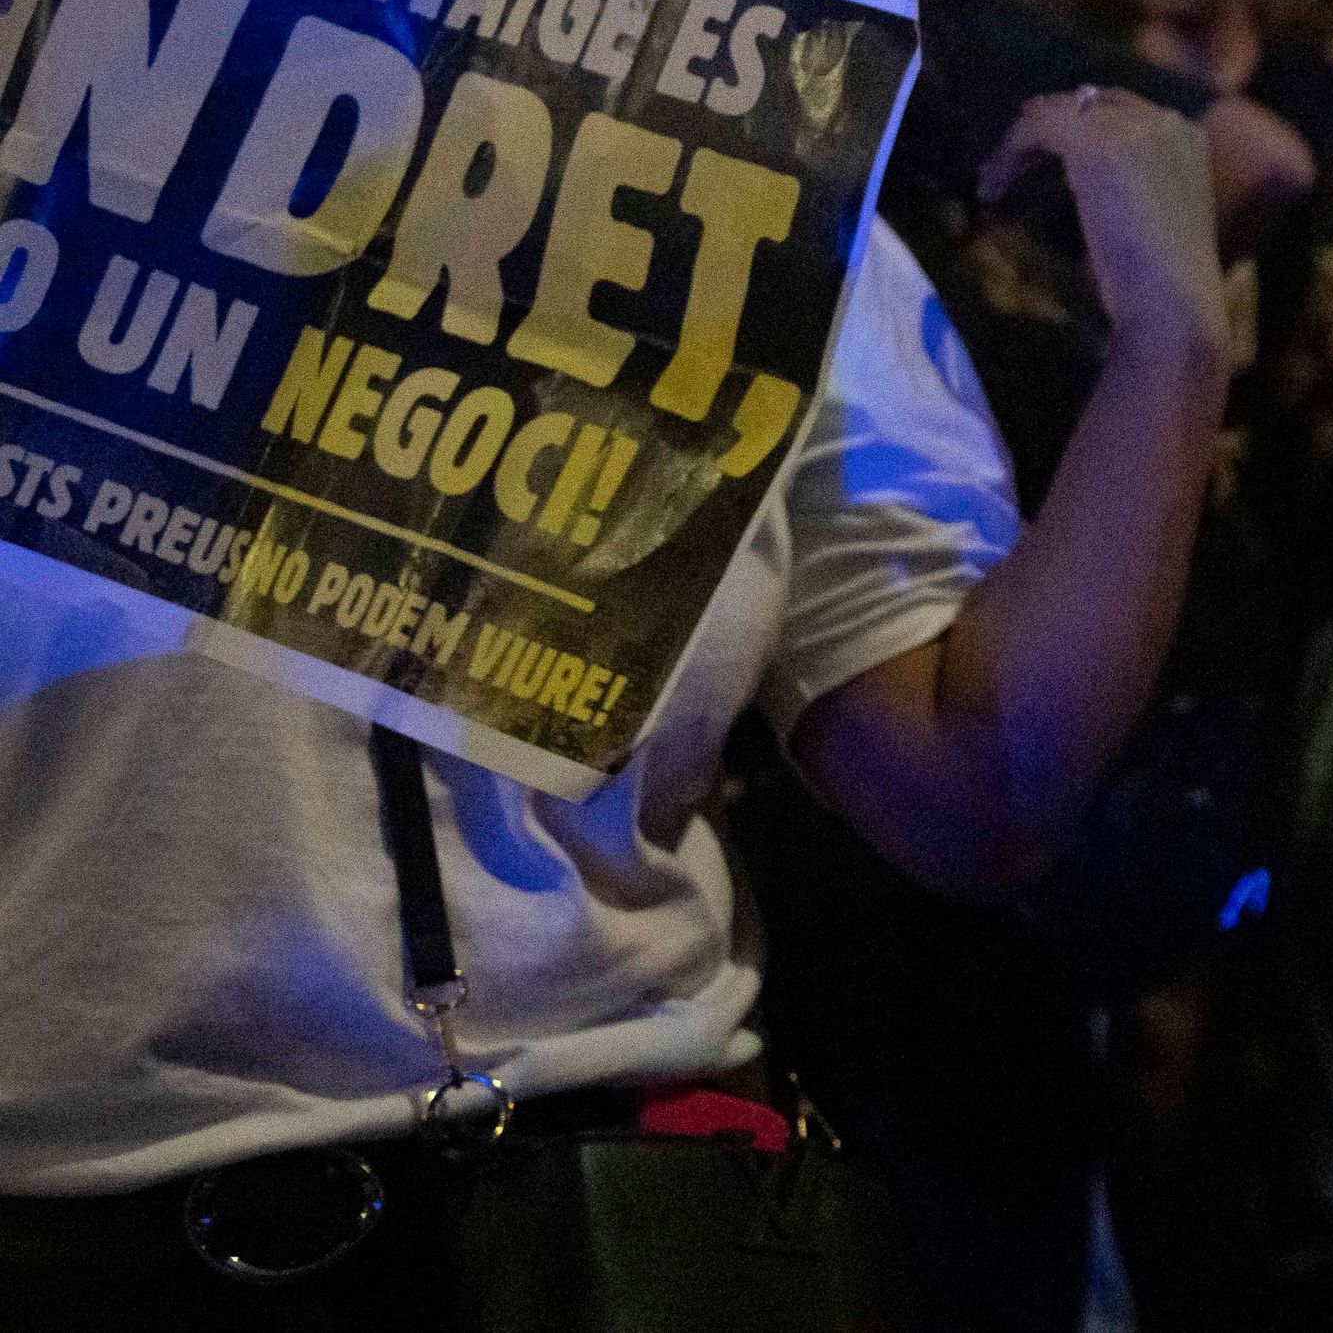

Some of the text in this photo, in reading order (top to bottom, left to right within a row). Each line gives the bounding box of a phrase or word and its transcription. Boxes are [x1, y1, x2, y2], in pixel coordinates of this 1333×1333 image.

[200, 13, 801, 479] DRET,
[76, 253, 261, 412] UN
[260, 323, 640, 548] NEGOCI!
[81, 478, 254, 584] PREUS
[248, 535, 311, 605] NO
[307, 561, 471, 666] PODEM
[467, 622, 629, 727] VIURE!
